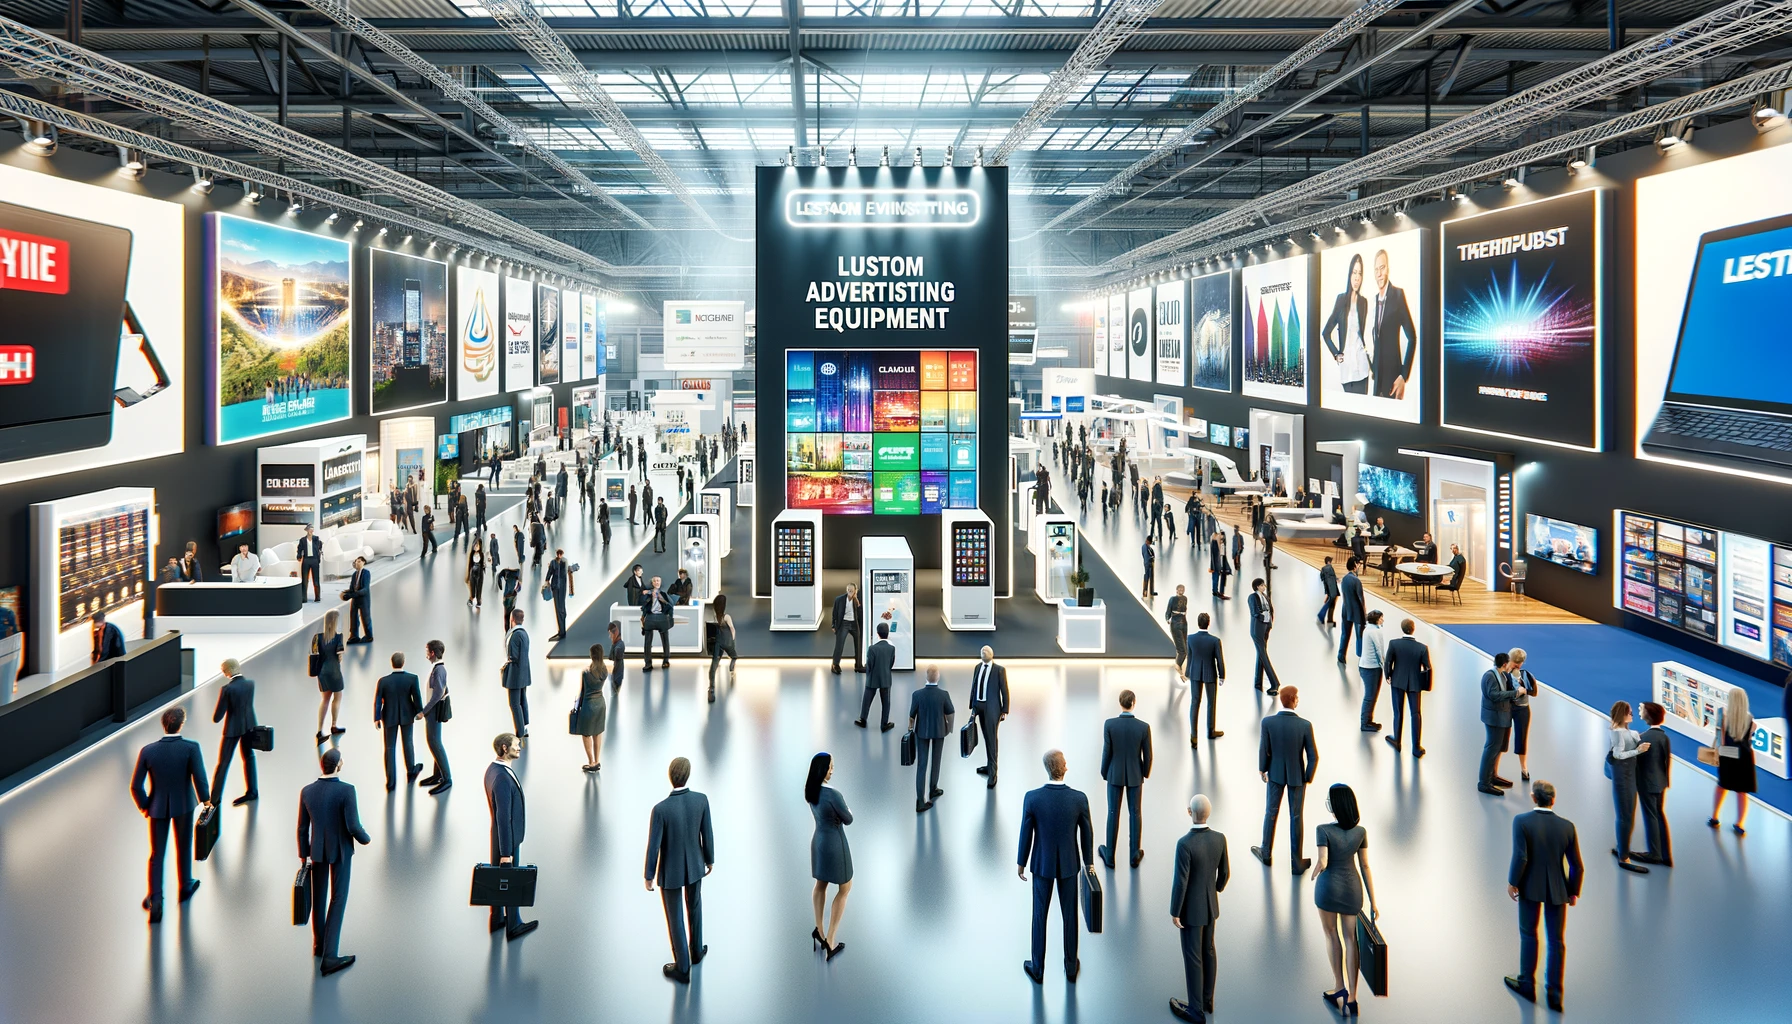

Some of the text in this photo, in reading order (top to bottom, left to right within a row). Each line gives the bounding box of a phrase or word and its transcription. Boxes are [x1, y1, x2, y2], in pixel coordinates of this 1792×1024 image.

[838, 256, 923, 277] LUSTOM
[805, 281, 955, 302] ADVERTISTING
[814, 307, 949, 333] EQUIPMENT
